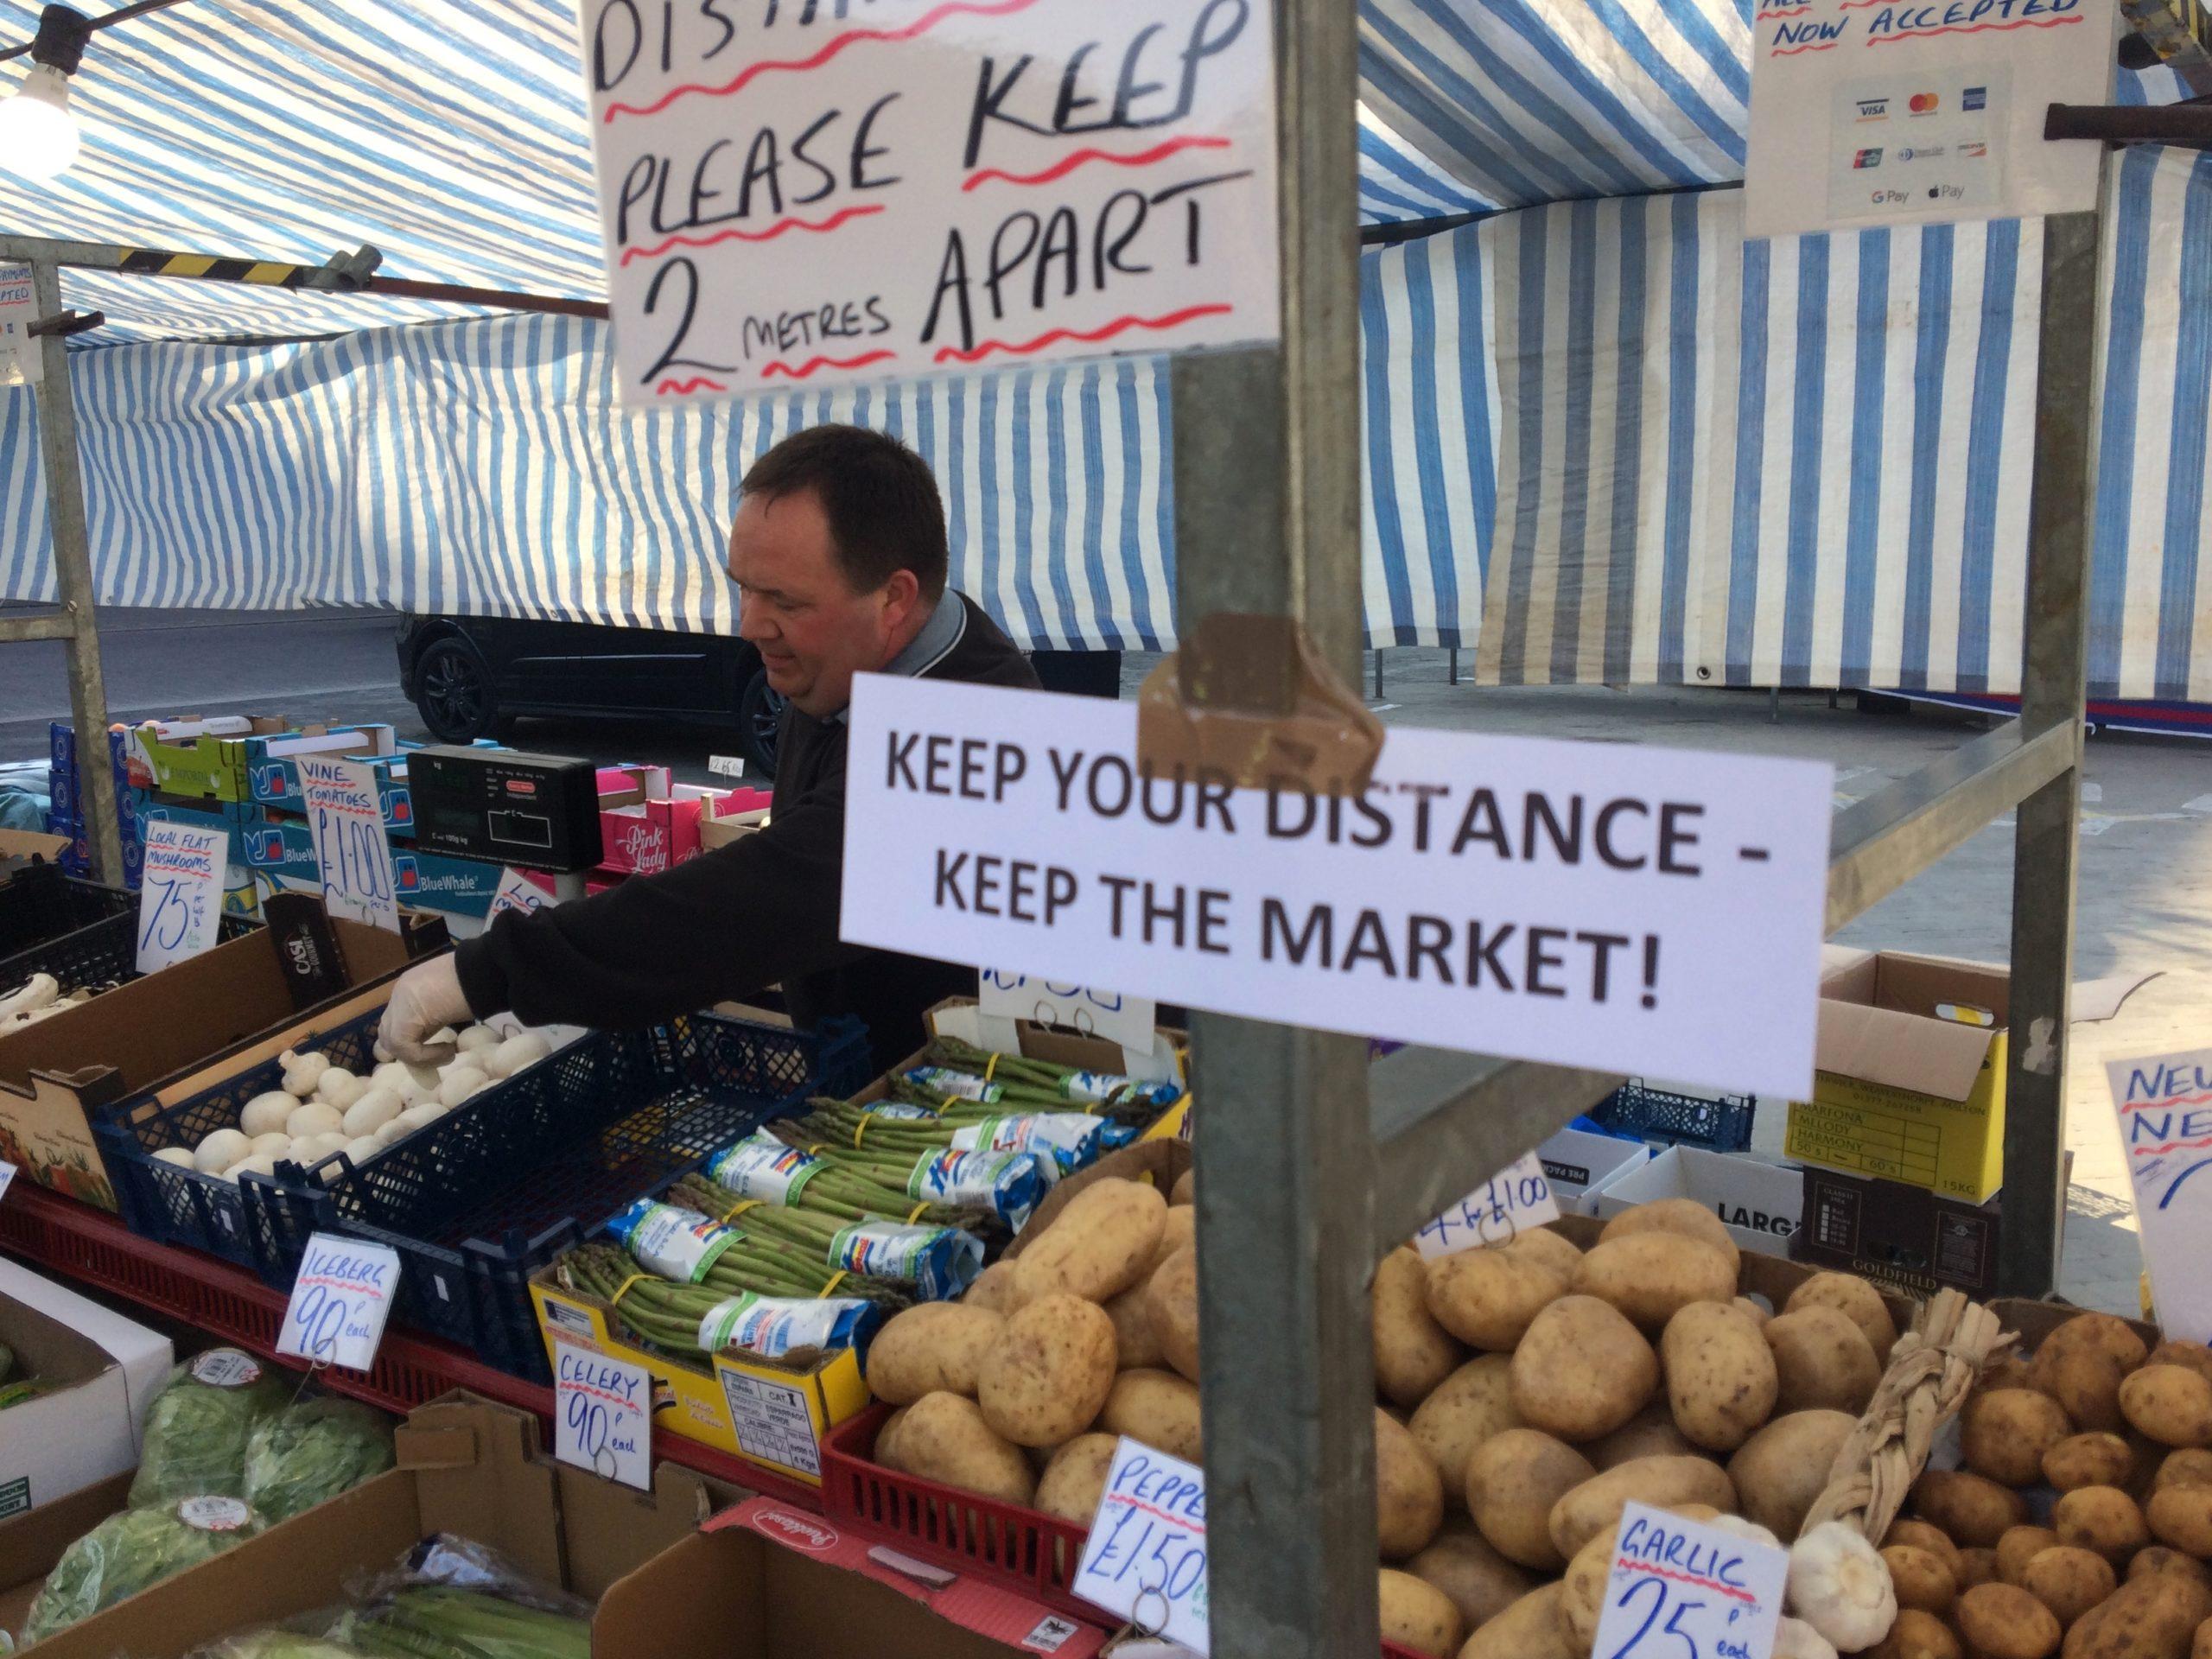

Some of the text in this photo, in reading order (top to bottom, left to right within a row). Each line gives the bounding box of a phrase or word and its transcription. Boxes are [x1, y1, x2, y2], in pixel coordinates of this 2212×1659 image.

[1772, 16, 1850, 46] NOW
[617, 0, 1249, 245] PLEASE KEEP
[1860, 105, 1885, 117] VISA
[1887, 189, 1910, 205] Pay
[1942, 184, 1965, 200] Pay
[641, 171, 1255, 385] 2 METRES APART
[300, 760, 351, 781] VINE
[307, 786, 372, 808] TOMATOES
[886, 731, 1027, 805] KEEP
[1048, 747, 1237, 835] YOUR
[1266, 772, 1707, 878] DISTANCE
[149, 827, 218, 850] LOCAL FLAT
[319, 807, 390, 901] £1.00
[614, 824, 664, 855] Pink
[147, 850, 212, 873] MUSHROOMS
[632, 846, 667, 874] Lady
[142, 876, 192, 951] 75
[935, 848, 1663, 1012] KEEP THE MARKET!
[1797, 1127, 1863, 1153] HARMONY
[1798, 1115, 1852, 1135] MELODY
[1488, 1175, 1548, 1224] £1.00
[1943, 1179, 1979, 1197] 15KG
[304, 1247, 387, 1287] ICEBERG
[1853, 1259, 1937, 1290] GOLDFIELD
[296, 1285, 346, 1355] 90
[560, 1354, 639, 1401] CELERY
[568, 1391, 608, 1458] 90
[612, 1438, 637, 1453] each
[1087, 1505, 1206, 1600] £1.50
[1621, 1518, 1746, 1587] GARLIC
[1611, 1576, 1707, 1659] 25
